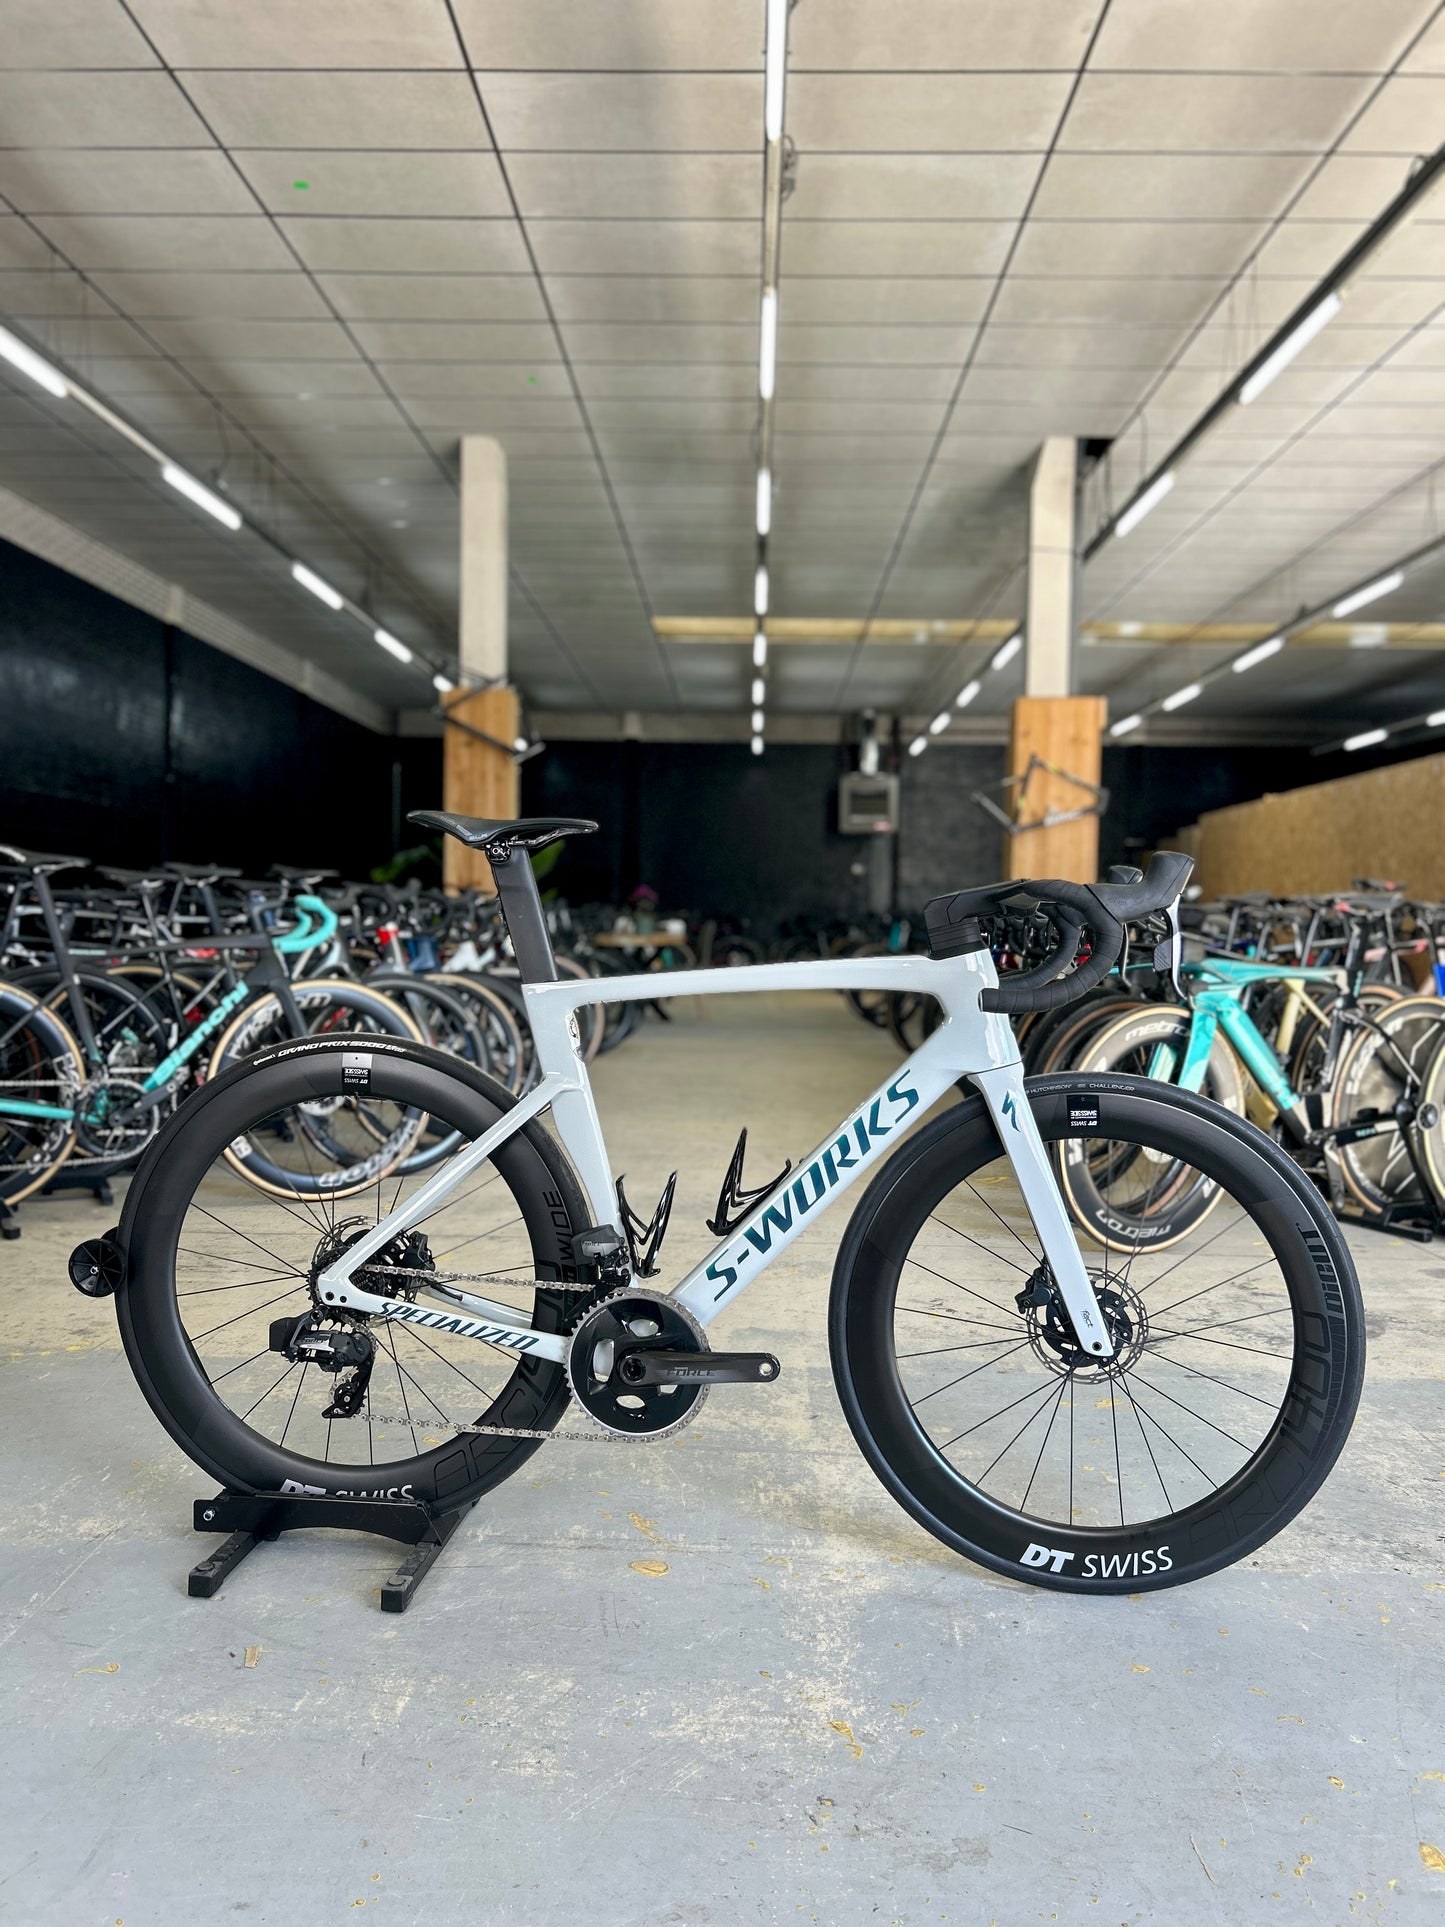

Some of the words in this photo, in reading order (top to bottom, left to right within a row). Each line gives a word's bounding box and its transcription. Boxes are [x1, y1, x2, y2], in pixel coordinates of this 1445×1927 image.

[151, 980, 249, 1086] Bianchi
[1125, 1020, 1191, 1041] metro
[277, 1043, 318, 1057] GRAND
[350, 1041, 386, 1049] 5000
[1030, 1084, 1071, 1094] HUTCHINSON
[1089, 1083, 1135, 1091] CHALLENGER
[705, 1068, 921, 1302] S-WORKS
[542, 1190, 576, 1267] WIDE
[1096, 1209, 1172, 1239] metron
[379, 1302, 540, 1351] SPECIALIZED
[666, 1369, 716, 1377] FORCE
[1189, 1447, 1306, 1550] ARC
[1279, 1310, 1333, 1458] 1400
[1019, 1543, 1075, 1573] DT
[1081, 1546, 1173, 1578] SWISS
